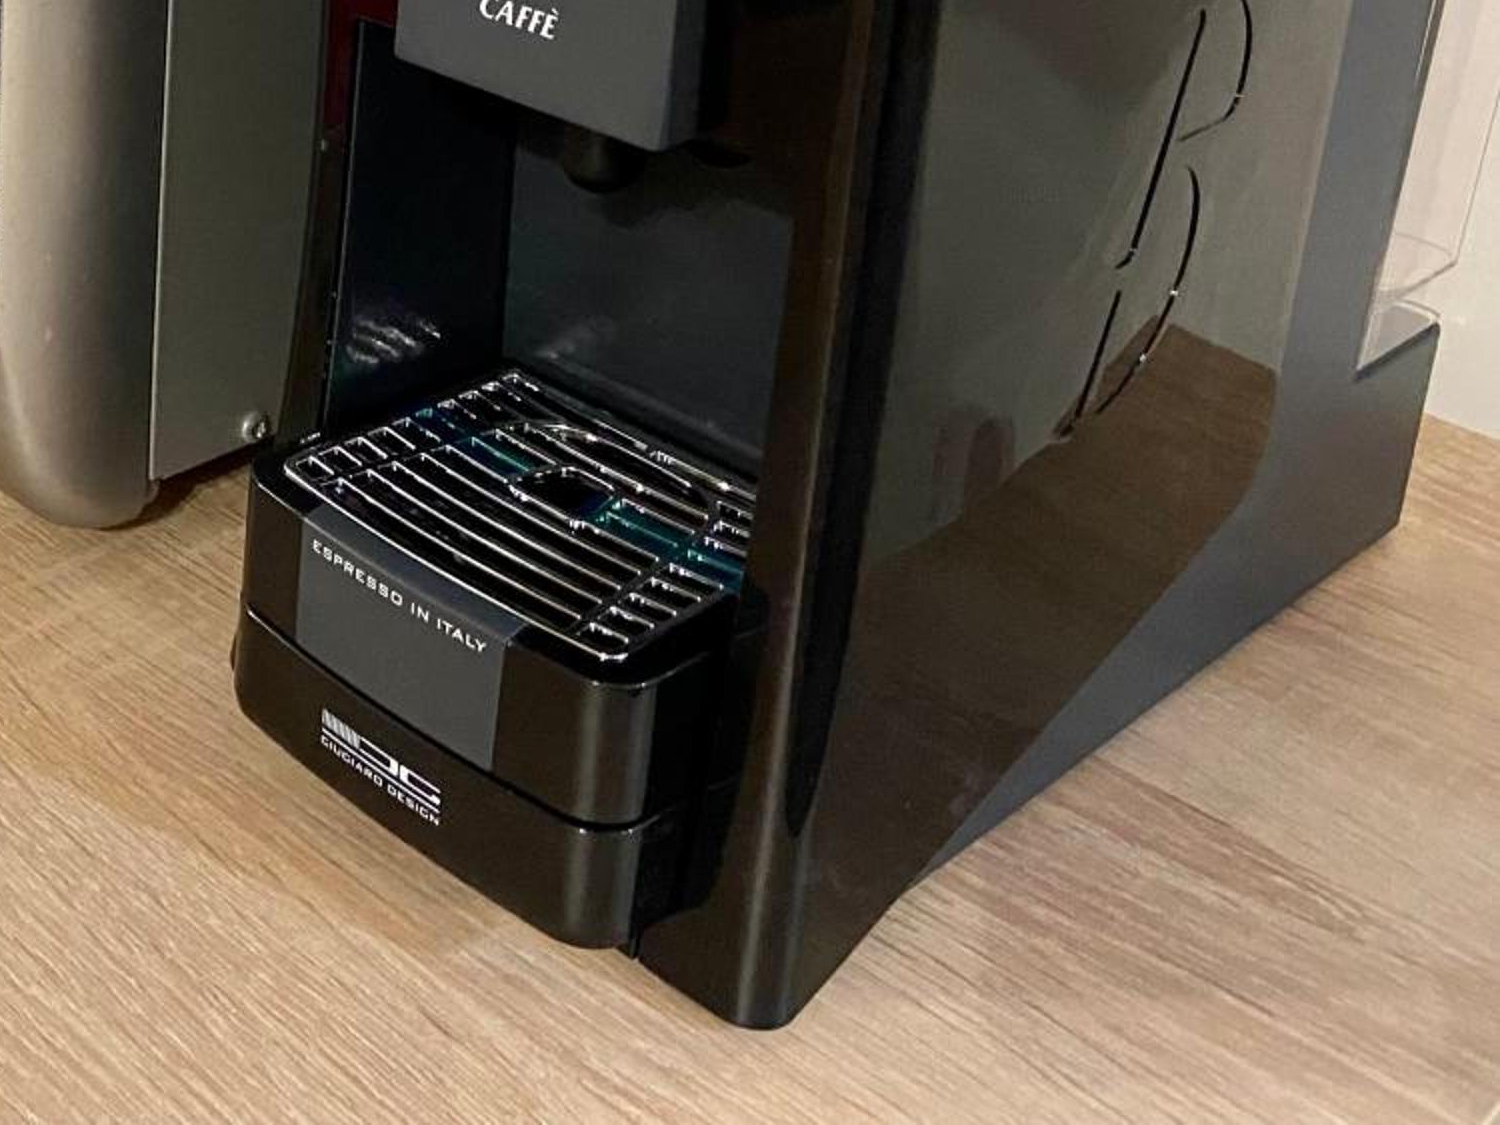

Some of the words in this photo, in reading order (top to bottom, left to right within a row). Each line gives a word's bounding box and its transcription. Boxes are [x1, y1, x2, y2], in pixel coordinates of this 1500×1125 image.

[312, 538, 403, 606] ESPRESSO
[410, 602, 430, 623] IN
[436, 617, 488, 652] ITALY
[321, 734, 383, 788] GIUGIARO
[386, 783, 440, 826] DESIGN
